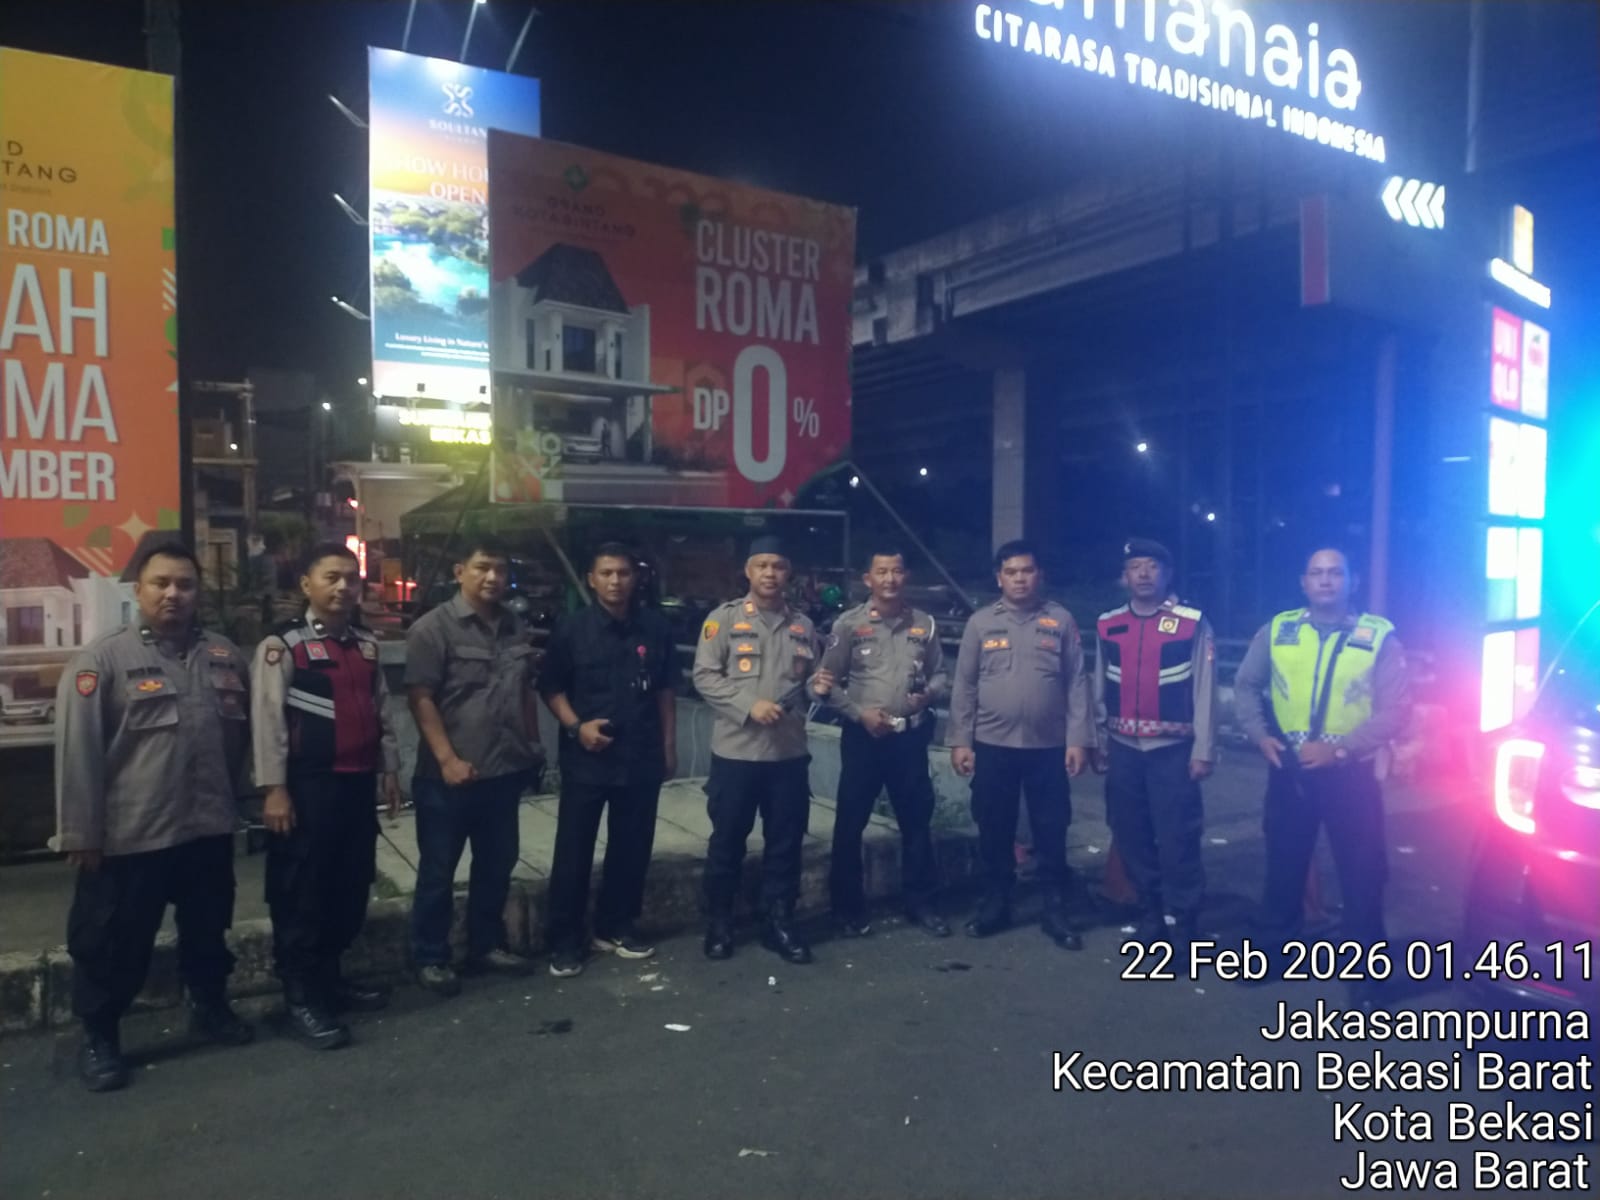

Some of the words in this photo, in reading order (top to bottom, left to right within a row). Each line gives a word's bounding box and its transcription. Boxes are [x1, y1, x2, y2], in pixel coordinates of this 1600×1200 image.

[975, 4, 1116, 78] CITARASA
[1282, 104, 1386, 163] INDONESIA
[1029, 0, 1362, 111] anaia
[1, 160, 78, 184] TANG
[429, 181, 487, 206] OPEN
[7, 208, 109, 255] ROMA
[696, 218, 821, 281] CLUSTER
[0, 263, 108, 357] AH
[696, 267, 821, 345] ROMA
[4, 359, 118, 443] MA
[693, 386, 730, 431] DP
[732, 344, 788, 484] 0
[793, 397, 820, 438] %
